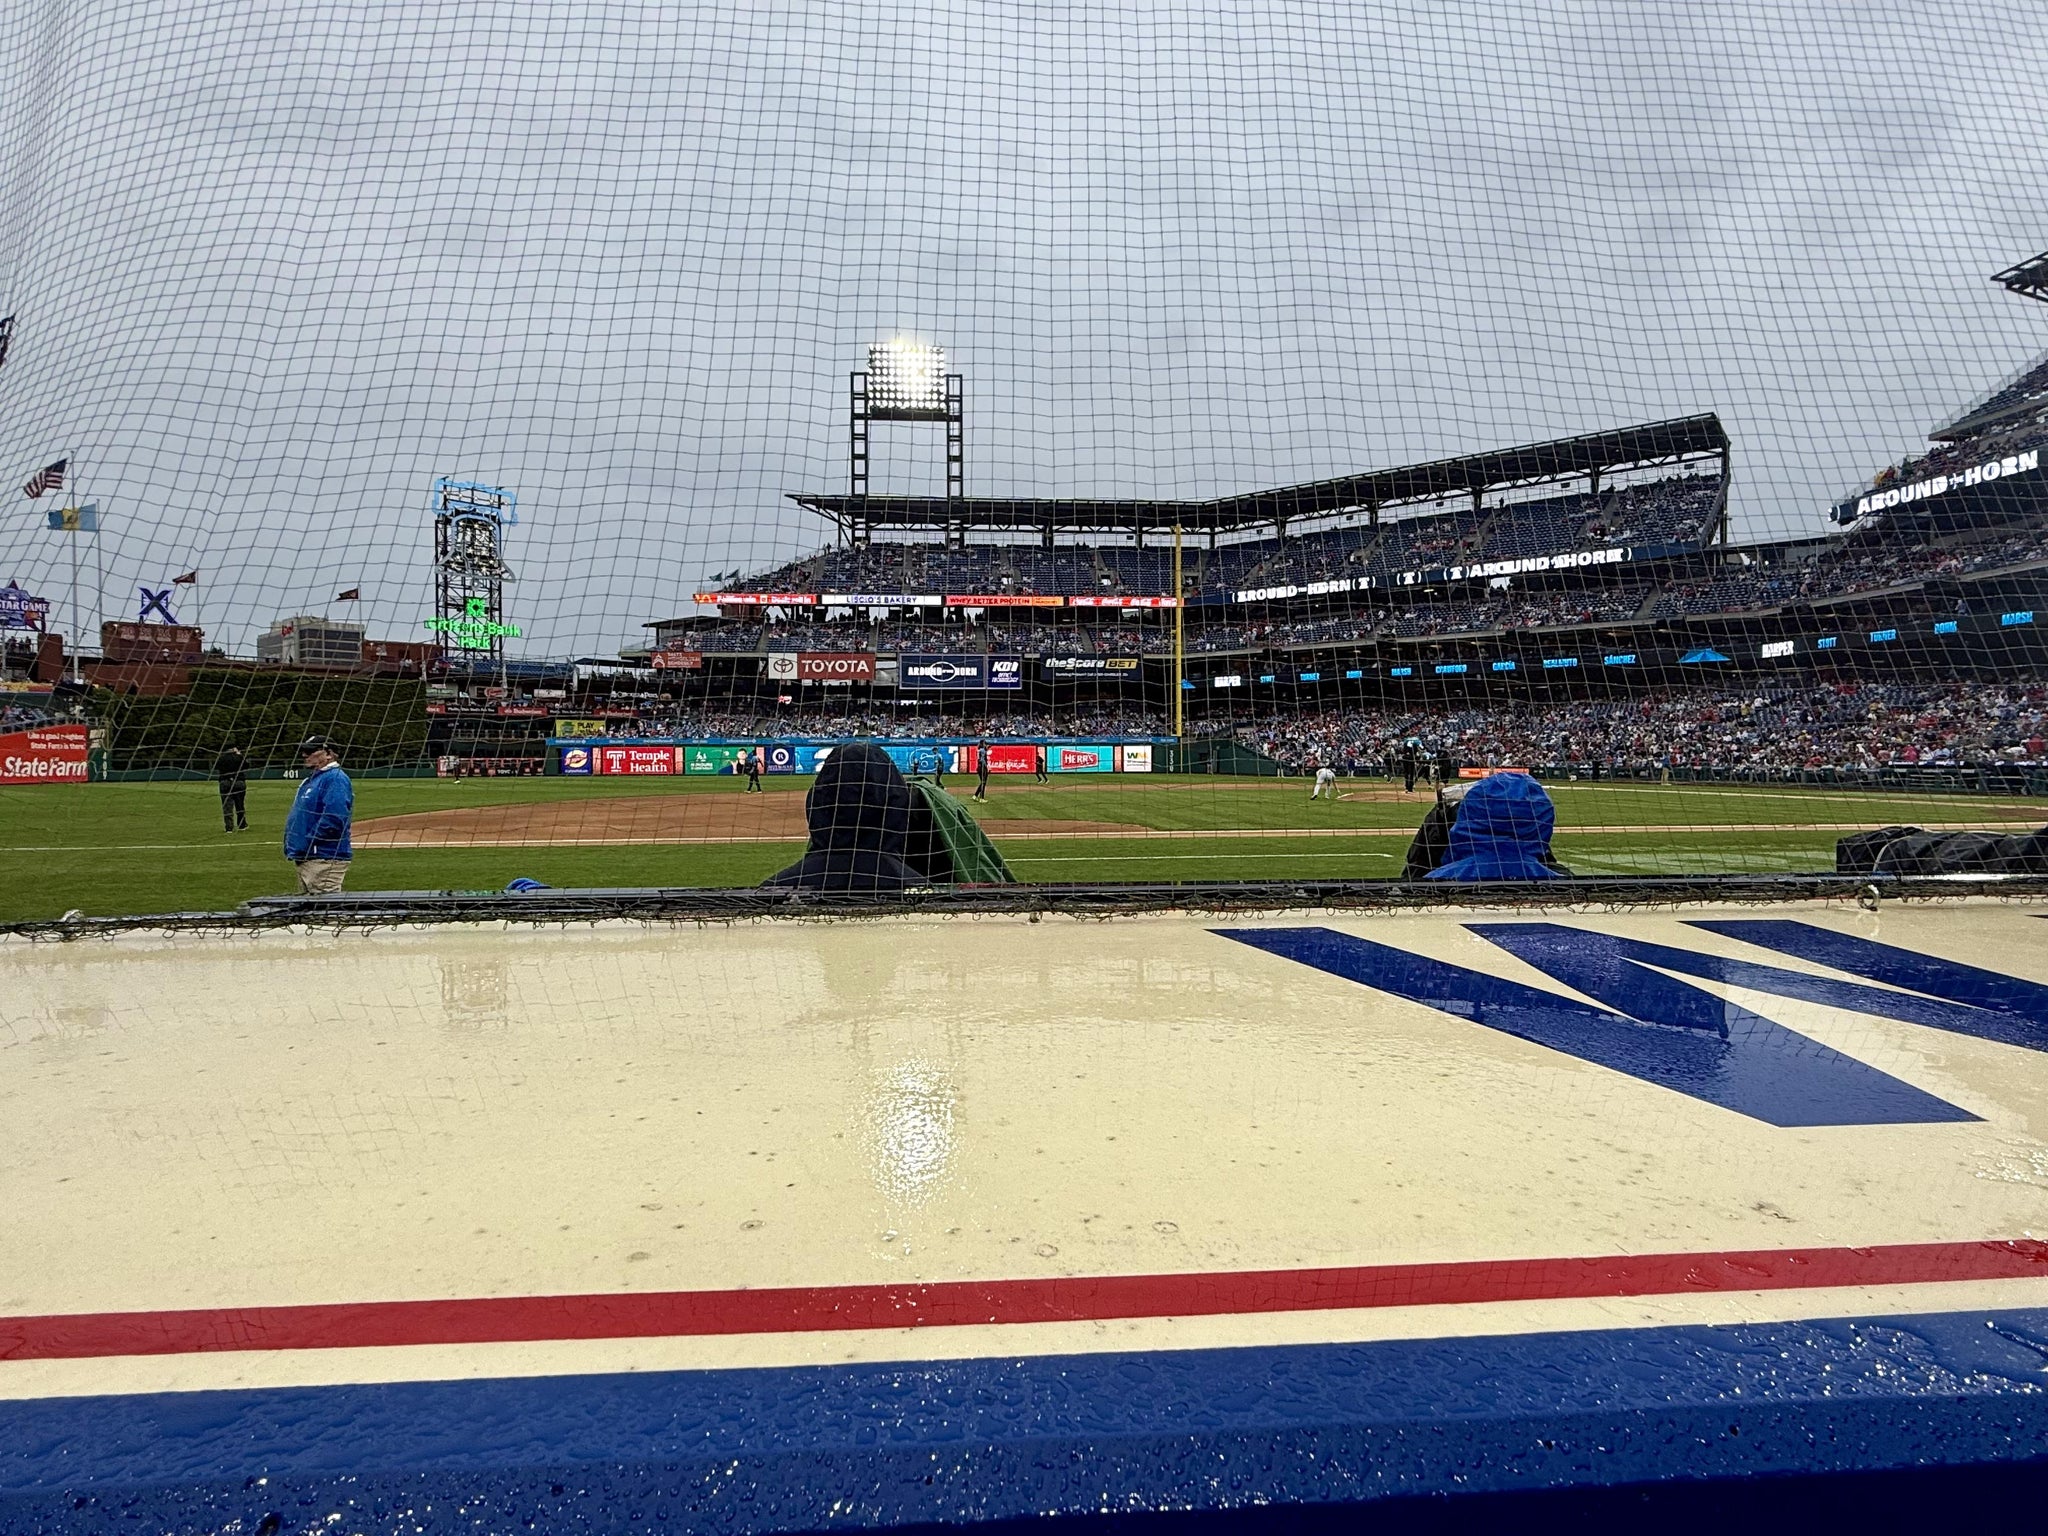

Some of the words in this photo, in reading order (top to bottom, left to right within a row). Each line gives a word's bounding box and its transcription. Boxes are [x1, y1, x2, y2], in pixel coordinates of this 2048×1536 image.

[1857, 475, 1948, 515] AROUND
[1964, 450, 2039, 487] HORN
[21, 601, 48, 612] GAME
[2002, 611, 2033, 626] MARSH
[487, 621, 522, 636] Bank
[459, 637, 490, 650] Park
[1817, 637, 1837, 649] STOTT
[1761, 641, 1794, 658] HARPER
[1045, 658, 1105, 670] theScore
[1604, 654, 1636, 666] SÁNCHEZ
[801, 660, 870, 673] TOYOTA
[908, 667, 942, 676] AROUND
[954, 667, 977, 676] HORN
[1260, 675, 1275, 684] STOTT
[629, 751, 670, 762] Temple
[1064, 754, 1094, 764] HERR'S
[630, 762, 667, 772] Health
[283, 770, 299, 778] 401
